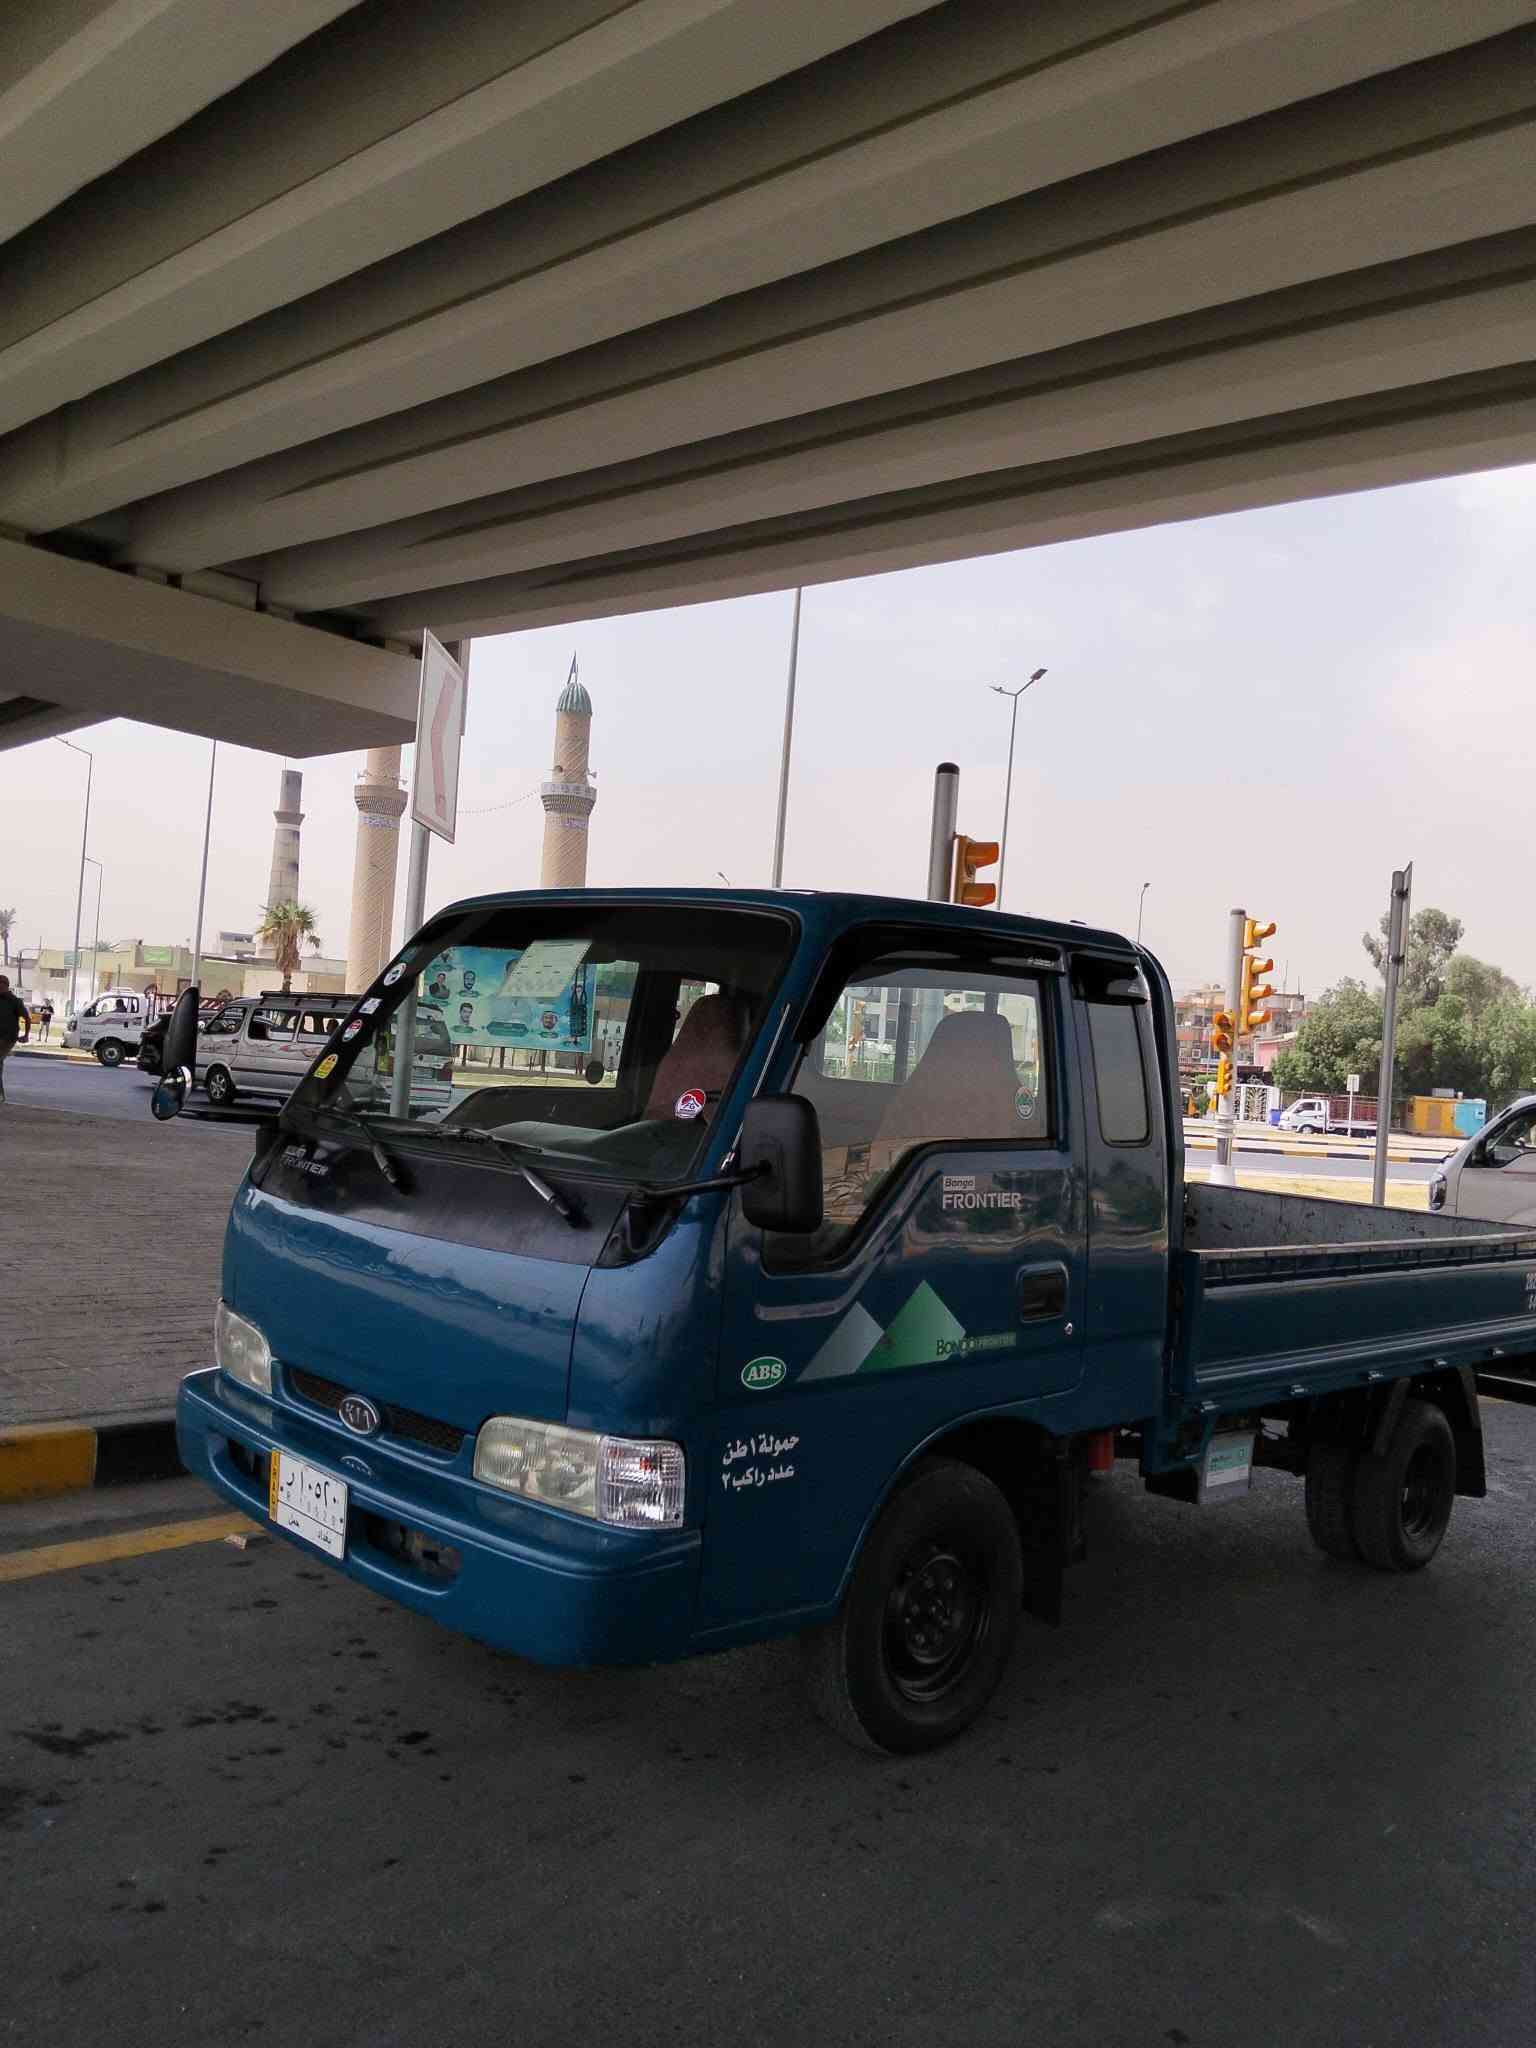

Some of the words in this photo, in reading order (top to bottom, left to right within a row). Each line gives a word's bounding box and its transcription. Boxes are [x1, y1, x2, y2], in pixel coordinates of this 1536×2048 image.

[942, 1192, 1023, 1210] FRONTIER
[746, 1364, 782, 1382] ABS
[758, 1433, 800, 1457] حمولة
[732, 1466, 766, 1492] راكب
[767, 1464, 795, 1481] عدد
